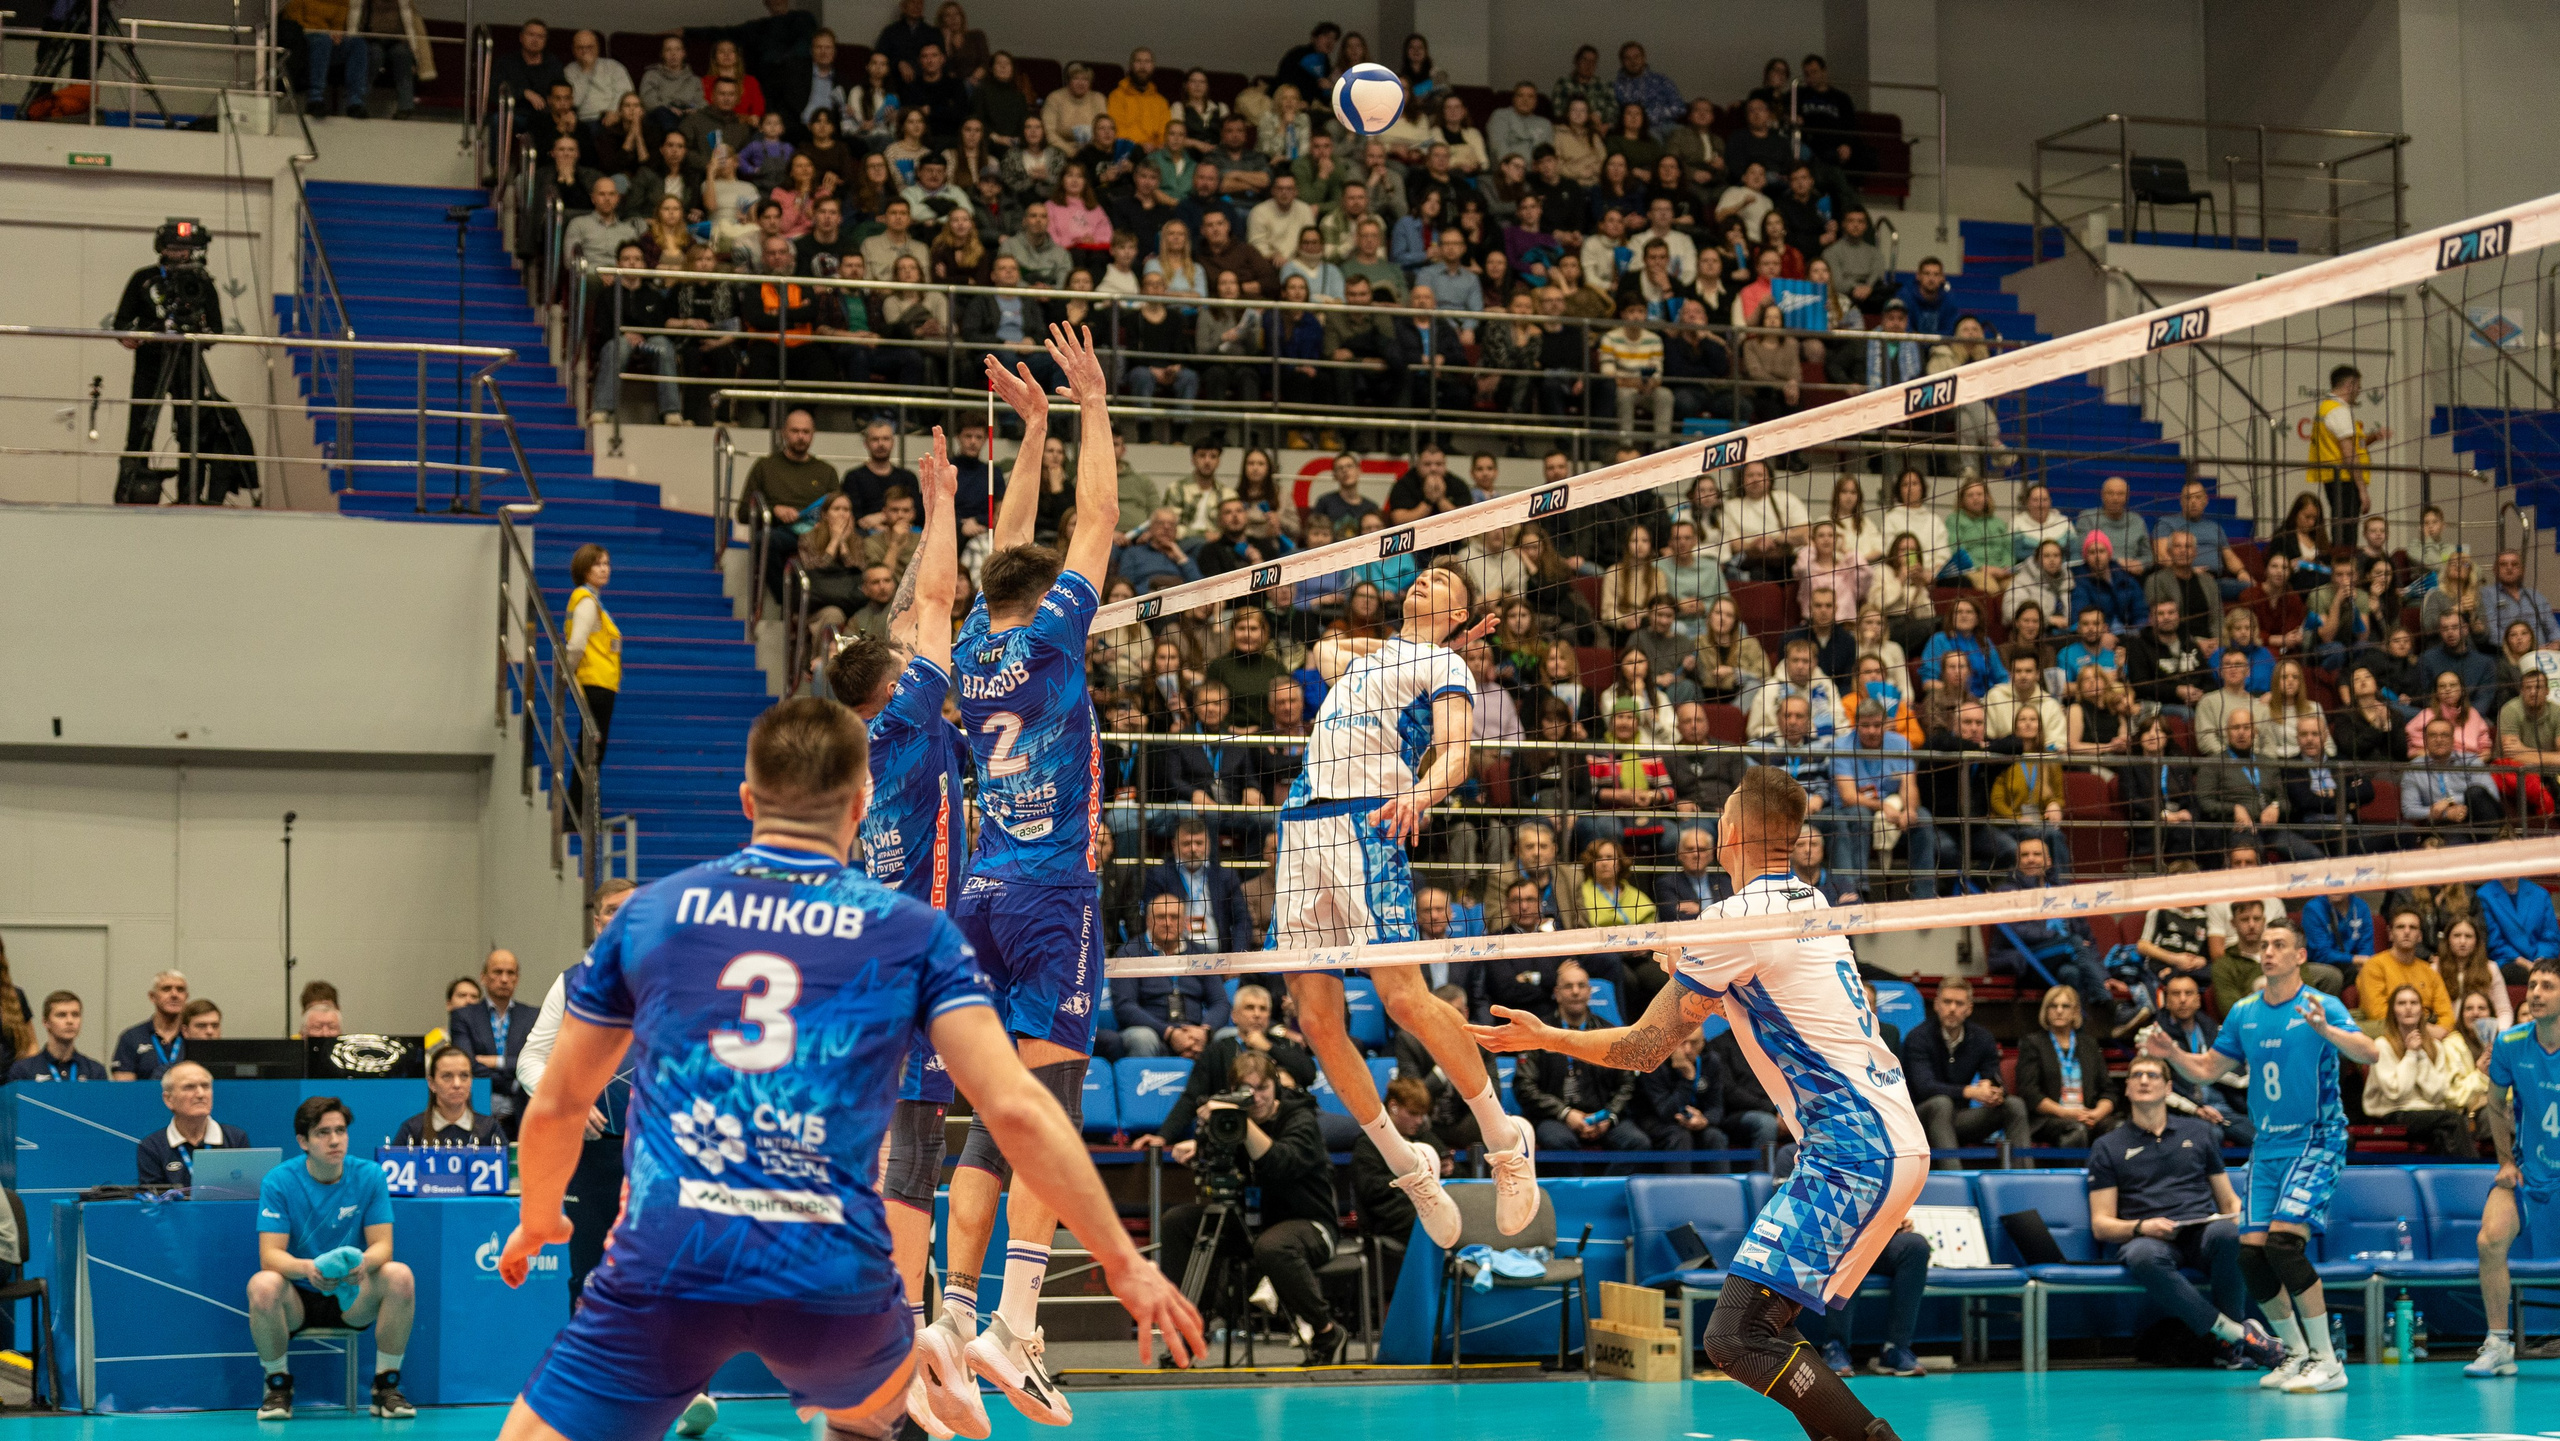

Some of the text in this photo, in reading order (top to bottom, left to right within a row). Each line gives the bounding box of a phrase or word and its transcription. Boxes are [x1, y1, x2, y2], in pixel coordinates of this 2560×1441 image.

[2442, 224, 2504, 268] PARI
[2150, 310, 2204, 348] PARI
[1908, 380, 1953, 412] PARI
[1705, 439, 1744, 470] PARI
[1531, 488, 1566, 514] PARI
[1382, 530, 1412, 555] PARI
[1252, 566, 1279, 588] PARI
[1137, 598, 1160, 618] PARI
[962, 661, 1030, 700] ВЛАСОВ
[981, 711, 1029, 779] 2
[1015, 782, 1057, 804] СИБ
[873, 829, 902, 850] СИБ
[1010, 823, 1044, 838] нгазея
[675, 887, 867, 940] ПАНКОВ
[1075, 904, 1093, 986] МАРИНС ГРУПП
[709, 950, 803, 1074] 3
[1835, 959, 1873, 1039] 9
[2262, 1060, 2282, 1102] 8
[753, 1102, 827, 1146] СИБ
[2541, 1100, 2560, 1139] 4
[382, 1160, 418, 1192] 24
[426, 1156, 462, 1173] 1 0
[470, 1159, 504, 1192] 21
